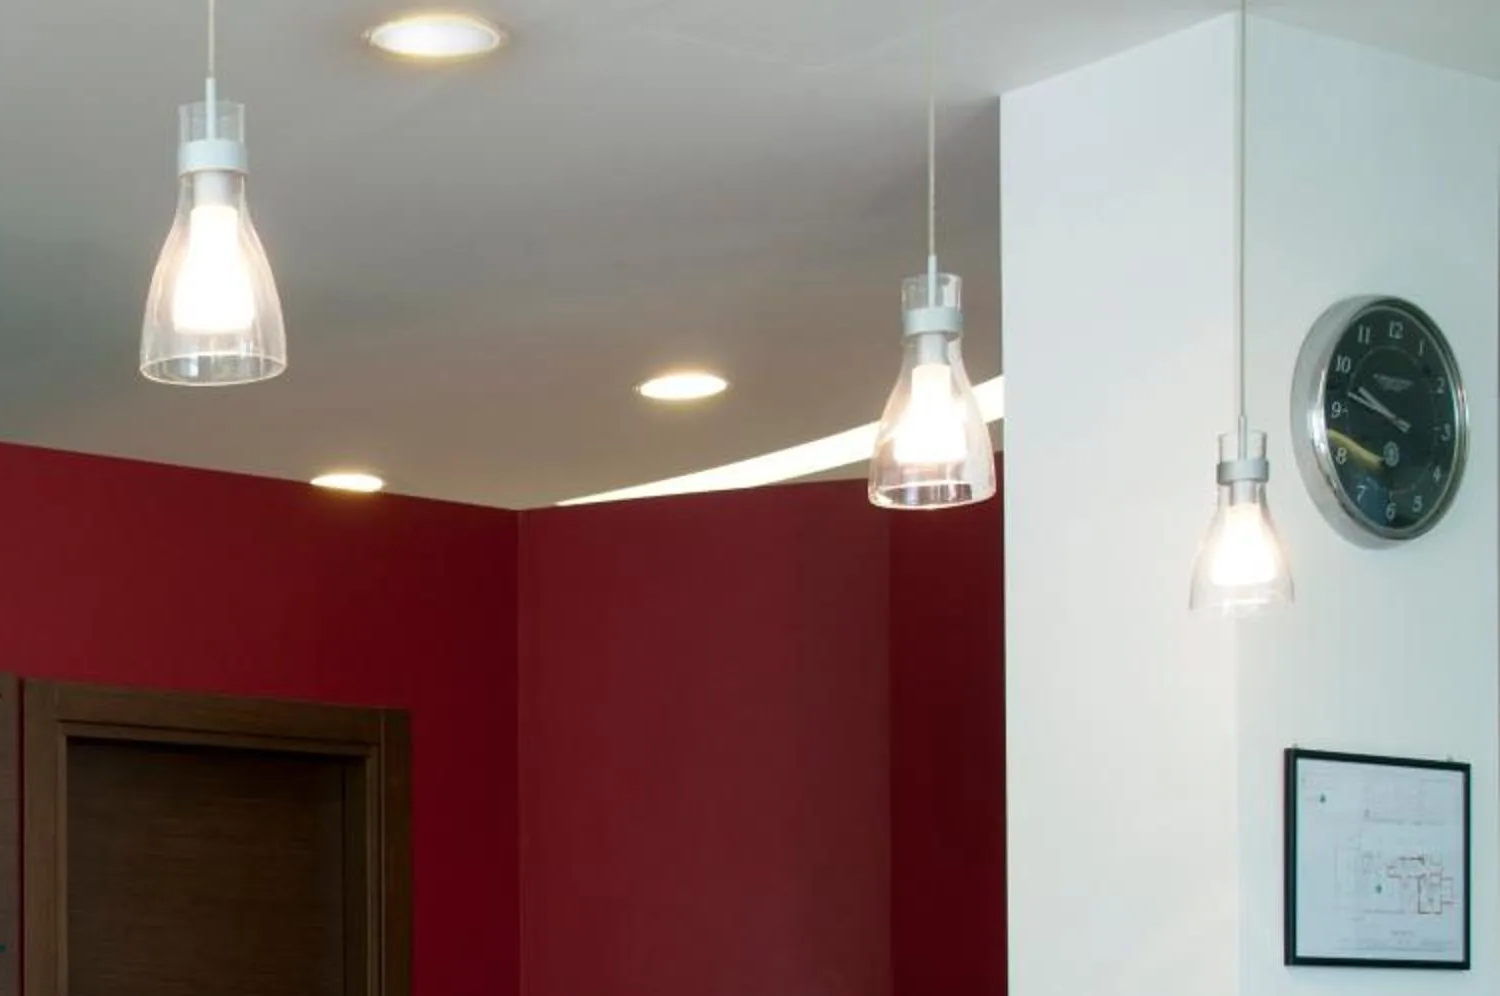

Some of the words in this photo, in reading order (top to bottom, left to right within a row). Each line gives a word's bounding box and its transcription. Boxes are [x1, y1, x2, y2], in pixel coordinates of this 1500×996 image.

[1357, 324, 1371, 345] 11
[1388, 320, 1404, 340] 12
[1419, 338, 1426, 357] 1
[1334, 354, 1351, 374] 10
[1436, 376, 1446, 394] 2
[1331, 400, 1342, 418] 9
[1440, 422, 1451, 442] 3
[1335, 446, 1347, 465] 8
[1355, 484, 1367, 502] 7
[1385, 502, 1397, 520] 6
[1412, 495, 1423, 513] 5
